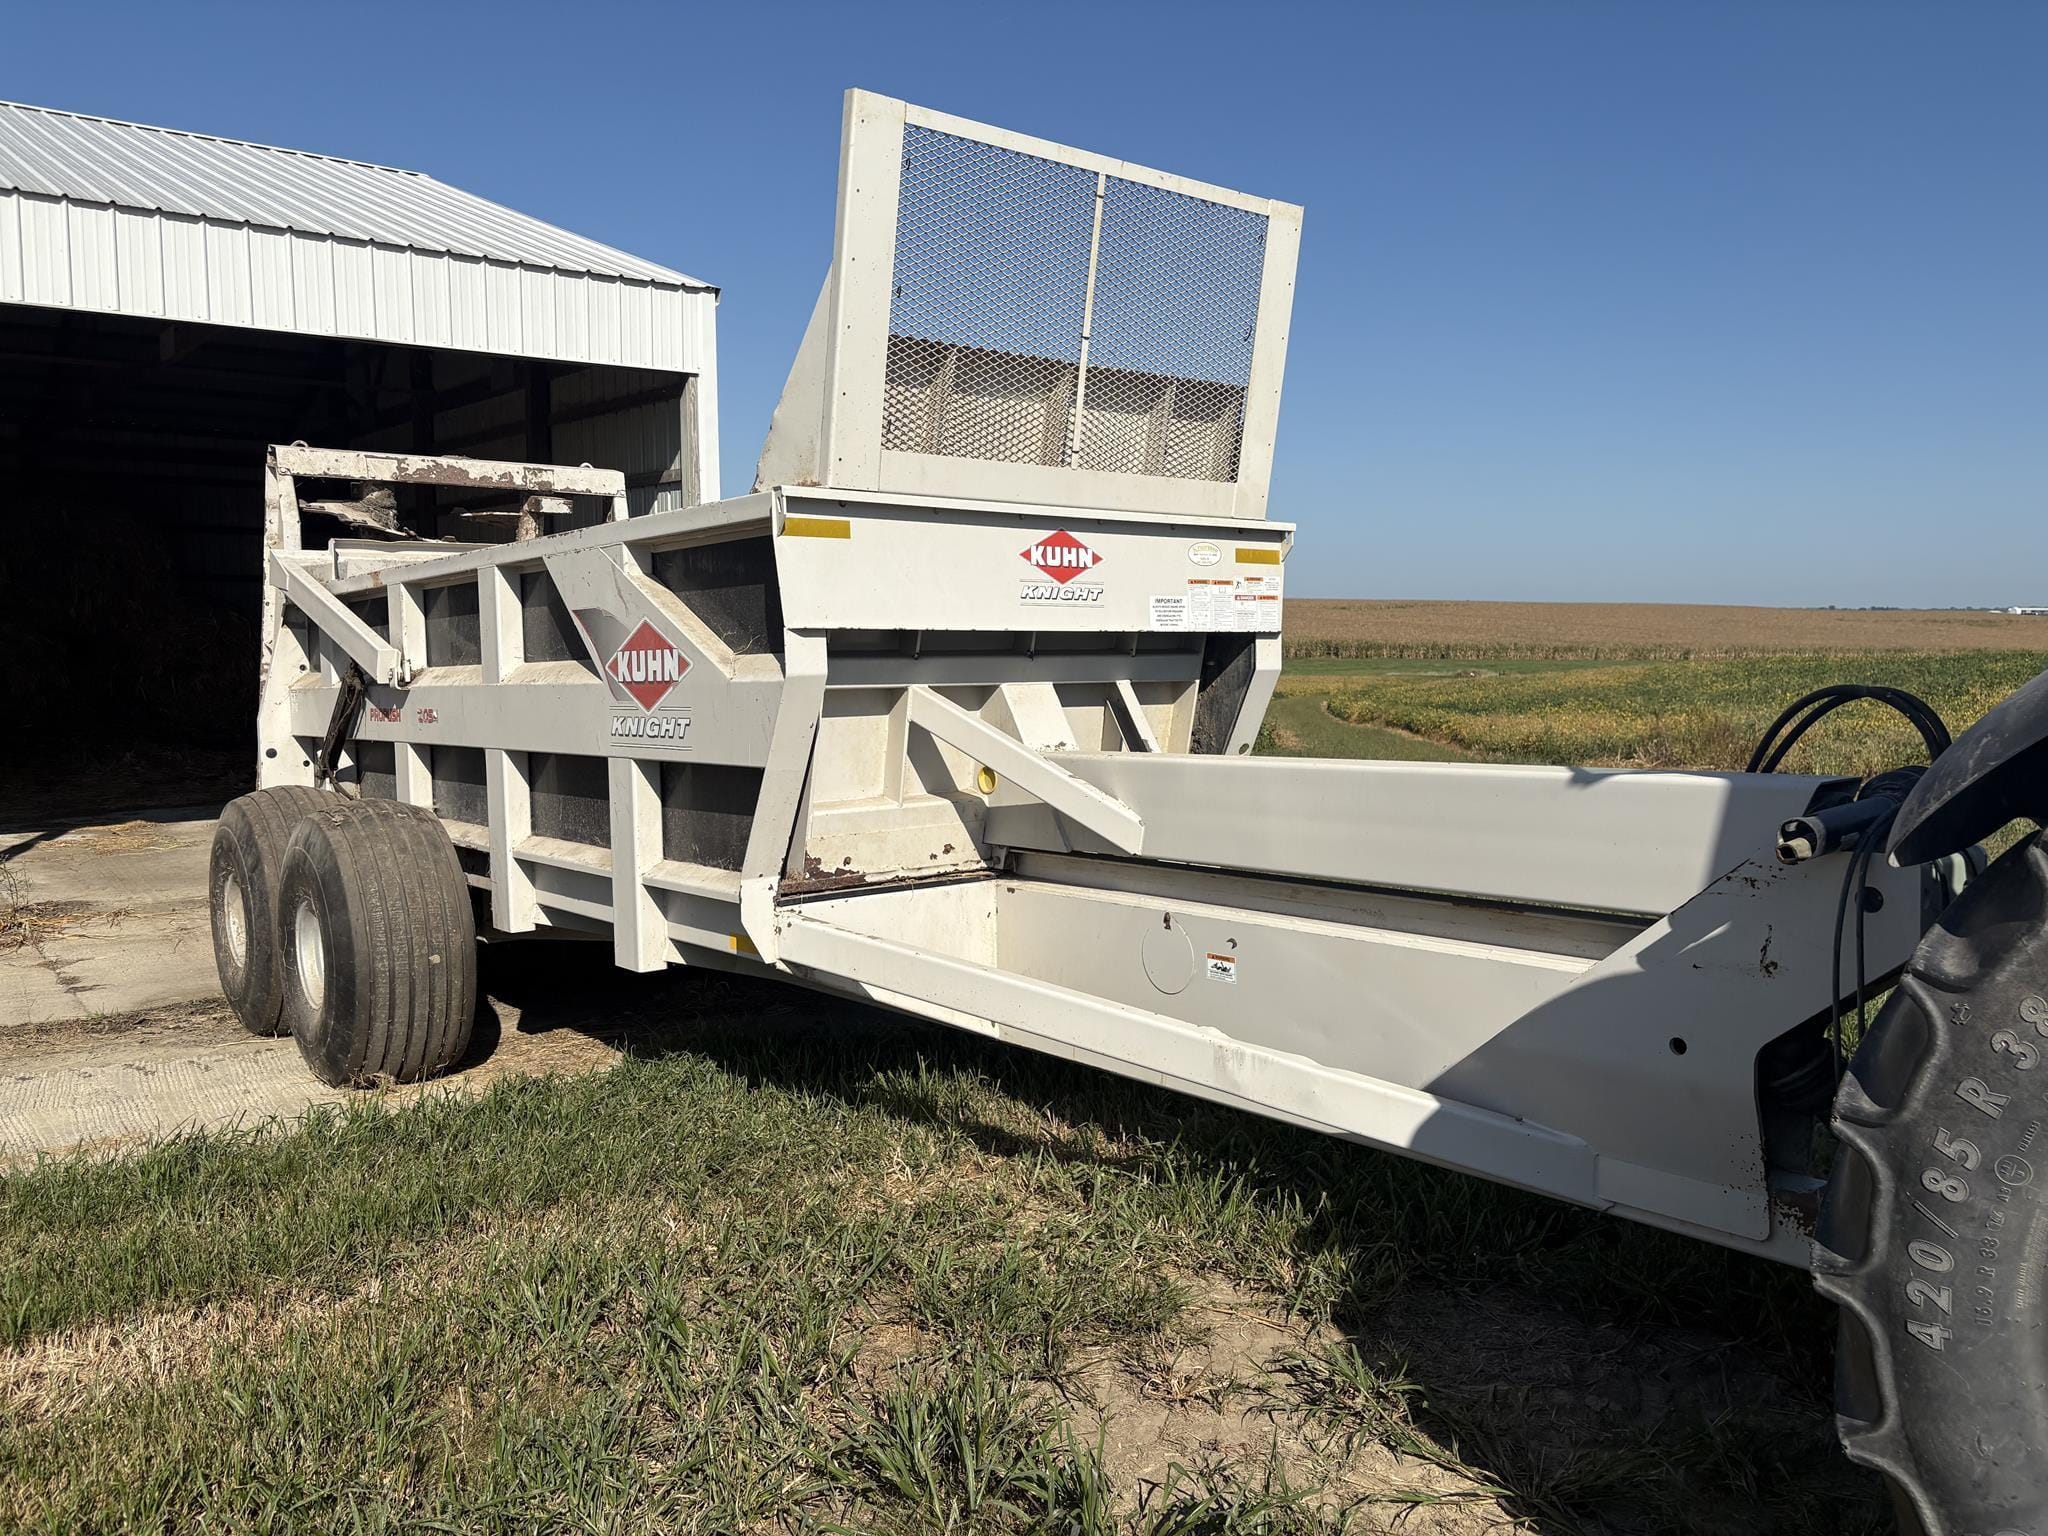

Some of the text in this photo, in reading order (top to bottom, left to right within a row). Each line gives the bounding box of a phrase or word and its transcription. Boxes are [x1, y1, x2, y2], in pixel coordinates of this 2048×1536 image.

[1030, 545, 1094, 568] KUHN
[1020, 585, 1104, 602] KNIGHT
[617, 648, 680, 683] KUHN
[611, 715, 692, 739] KNIGHT
[1905, 994, 2048, 1352] 420/85 R 38
[1976, 1264, 1996, 1279] R
[1974, 1285, 1994, 1327] 16.9
